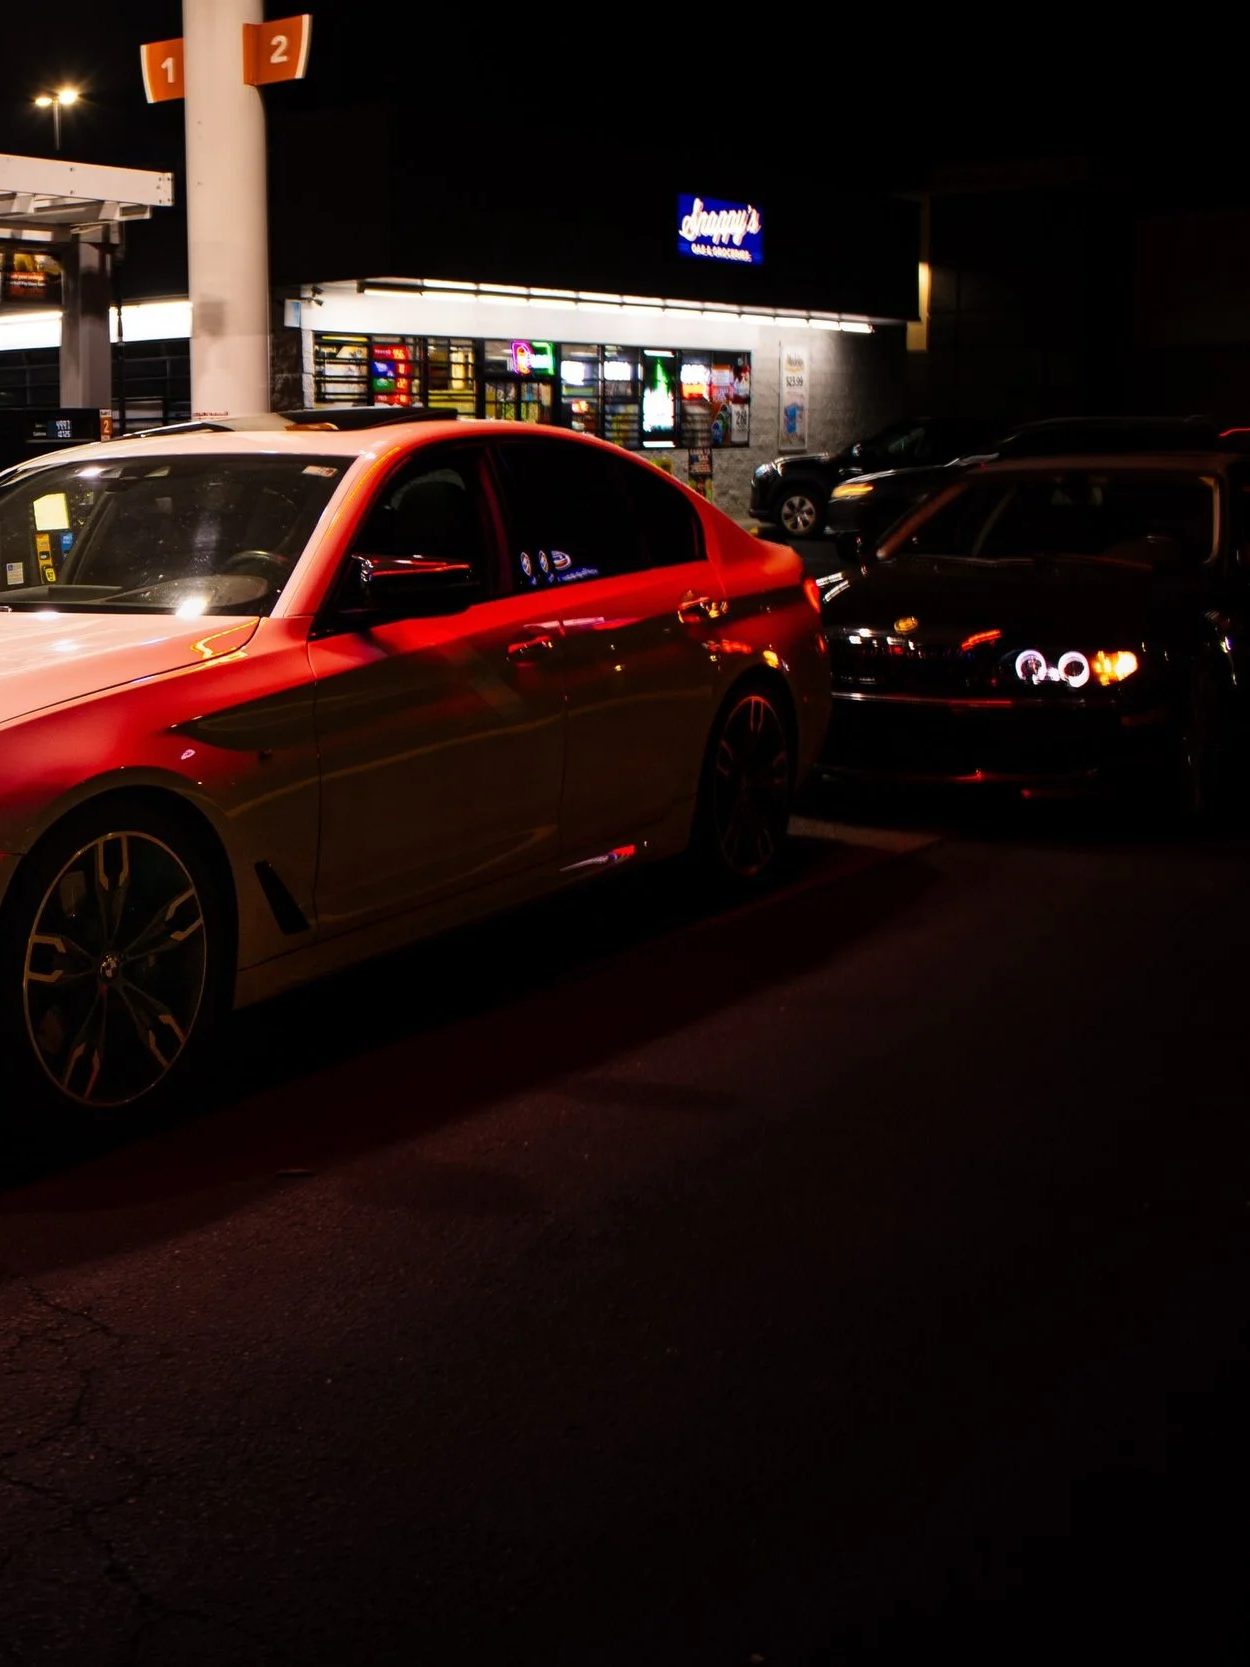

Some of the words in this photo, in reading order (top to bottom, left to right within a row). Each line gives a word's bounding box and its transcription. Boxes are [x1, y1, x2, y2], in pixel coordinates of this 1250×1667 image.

[270, 35, 288, 63] 2
[161, 57, 175, 83] 1
[679, 198, 761, 246] Snappy's
[103, 420, 109, 433] 2
